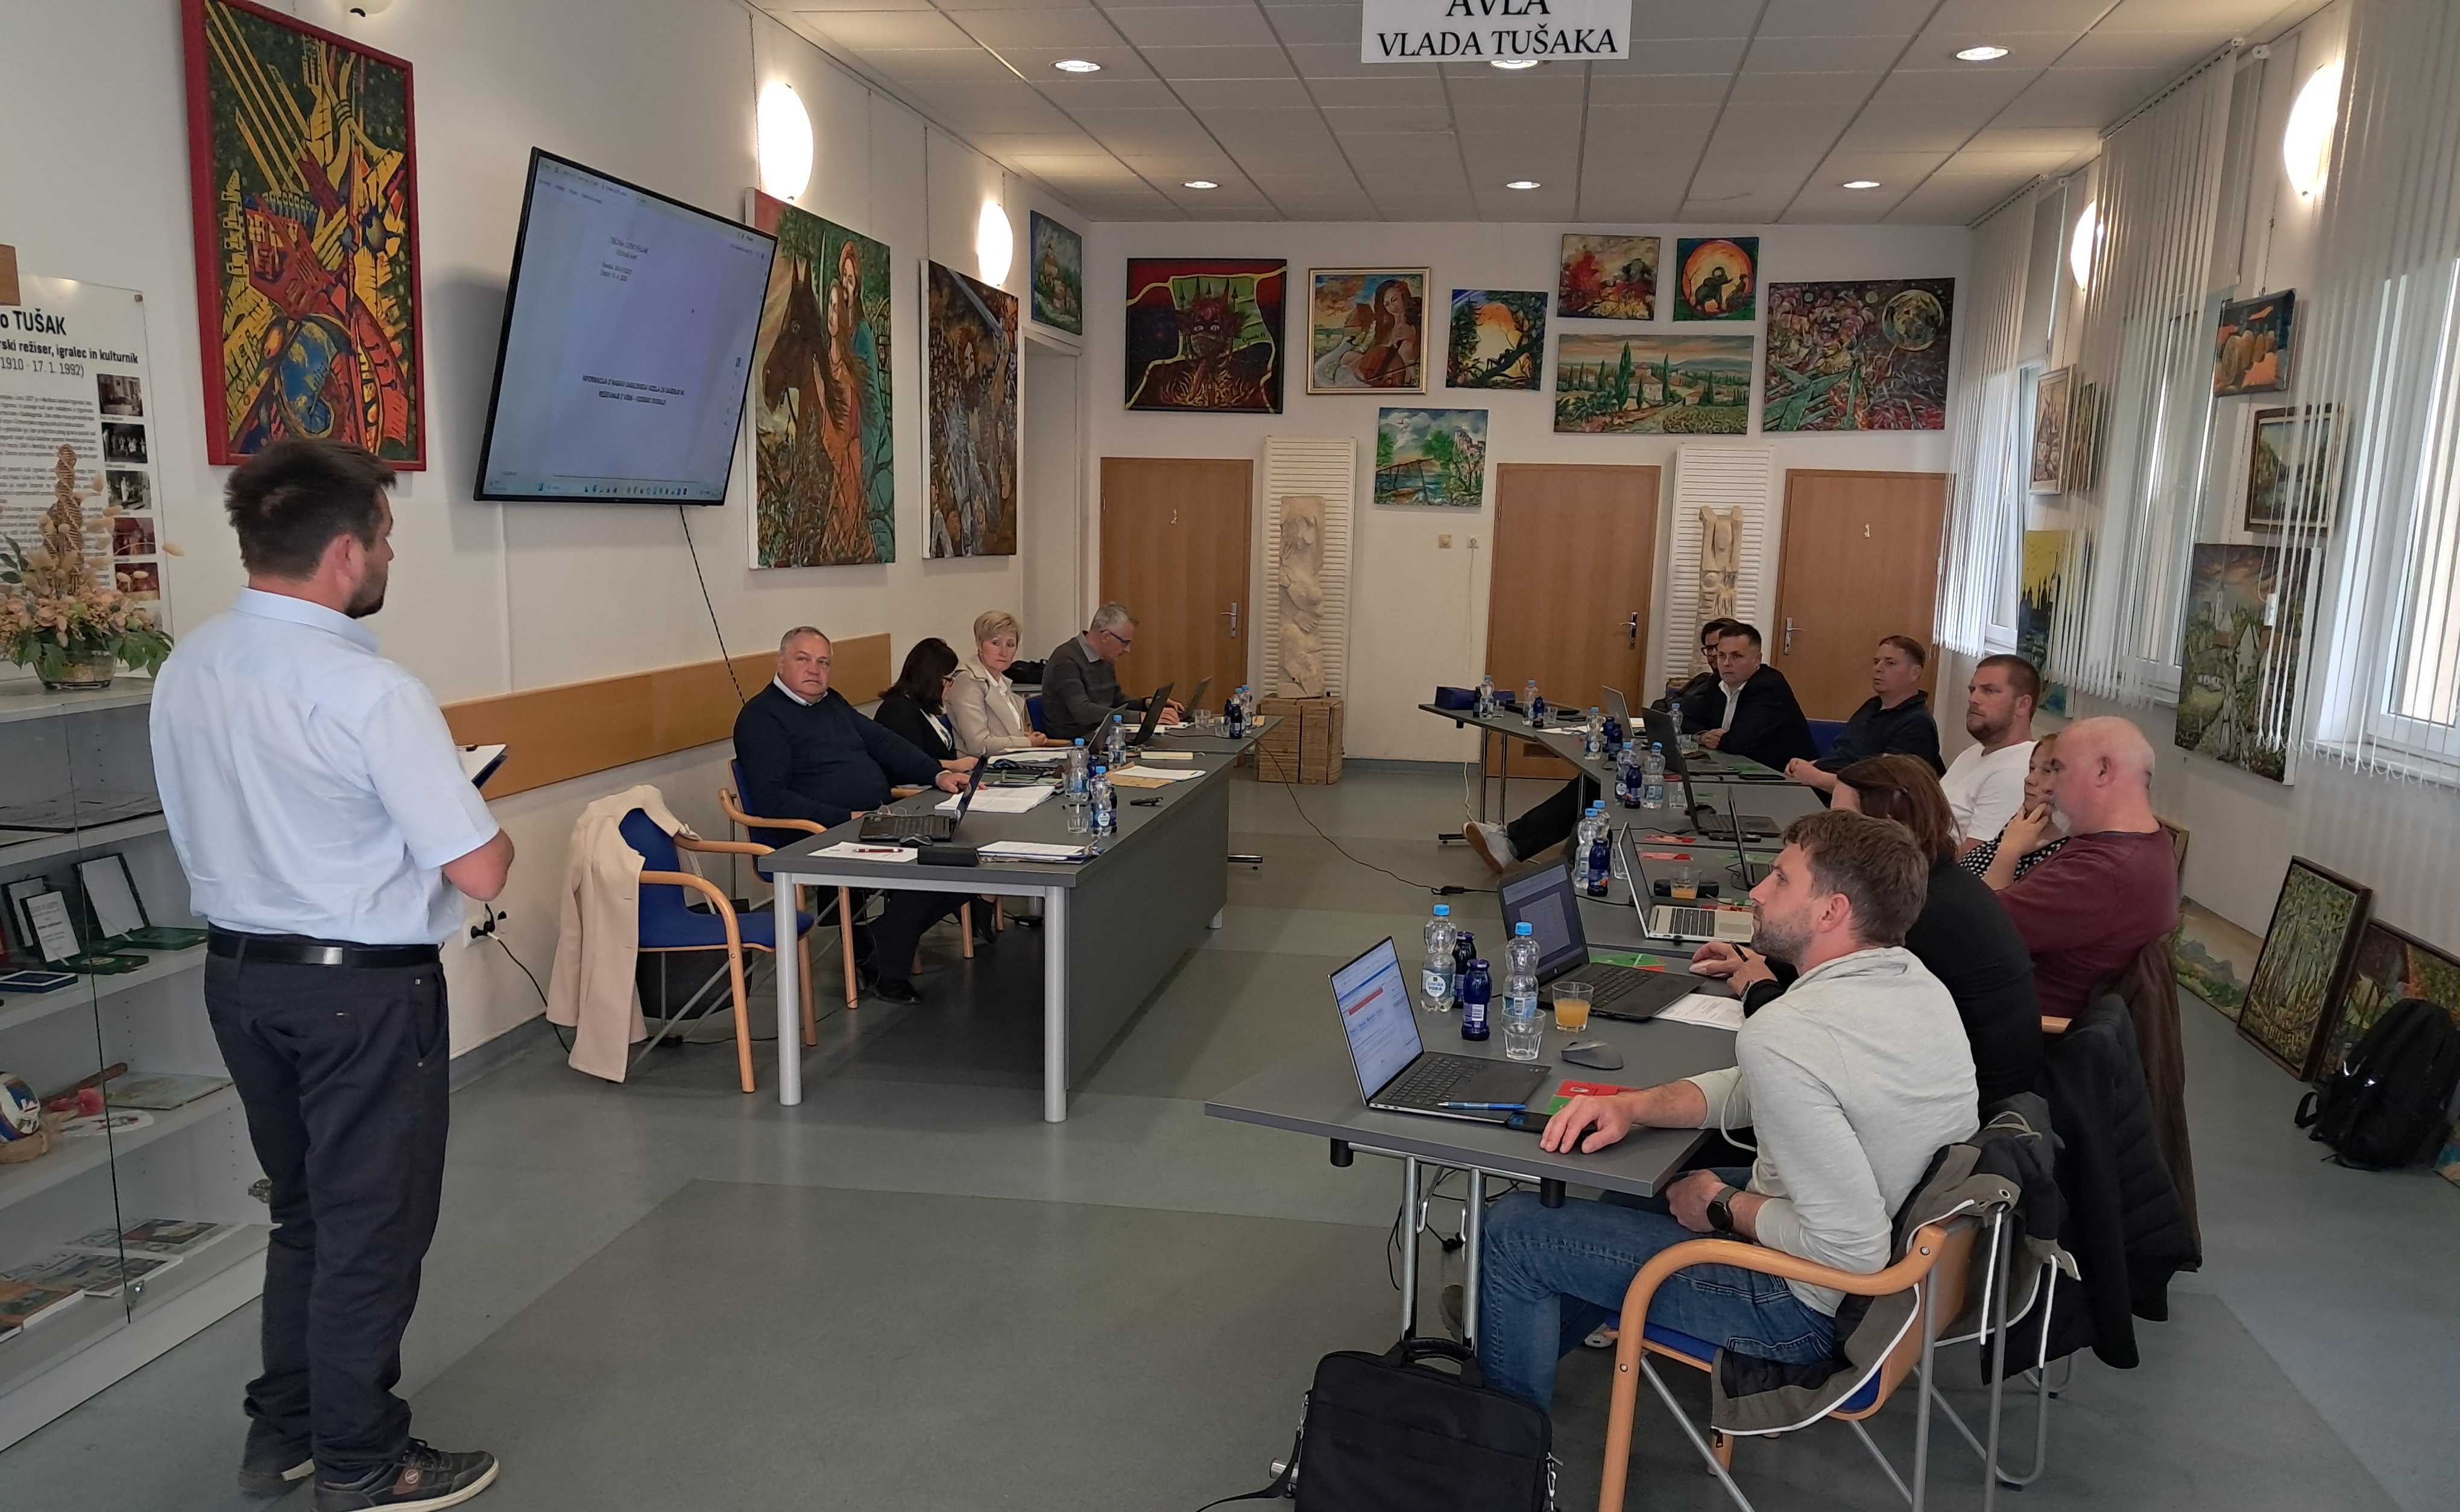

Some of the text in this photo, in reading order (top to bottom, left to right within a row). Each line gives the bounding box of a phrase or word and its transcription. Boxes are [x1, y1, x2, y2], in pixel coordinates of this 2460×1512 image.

[1377, 23, 1618, 57] VLADA TUŠAKA
[12, 308, 67, 336] TUŠAK
[19, 341, 54, 357] režiser,
[56, 344, 87, 359] igralec
[89, 347, 98, 360] in
[99, 349, 139, 364] kulturnik
[0, 356, 24, 370] 1910
[59, 362, 84, 378] 1992)
